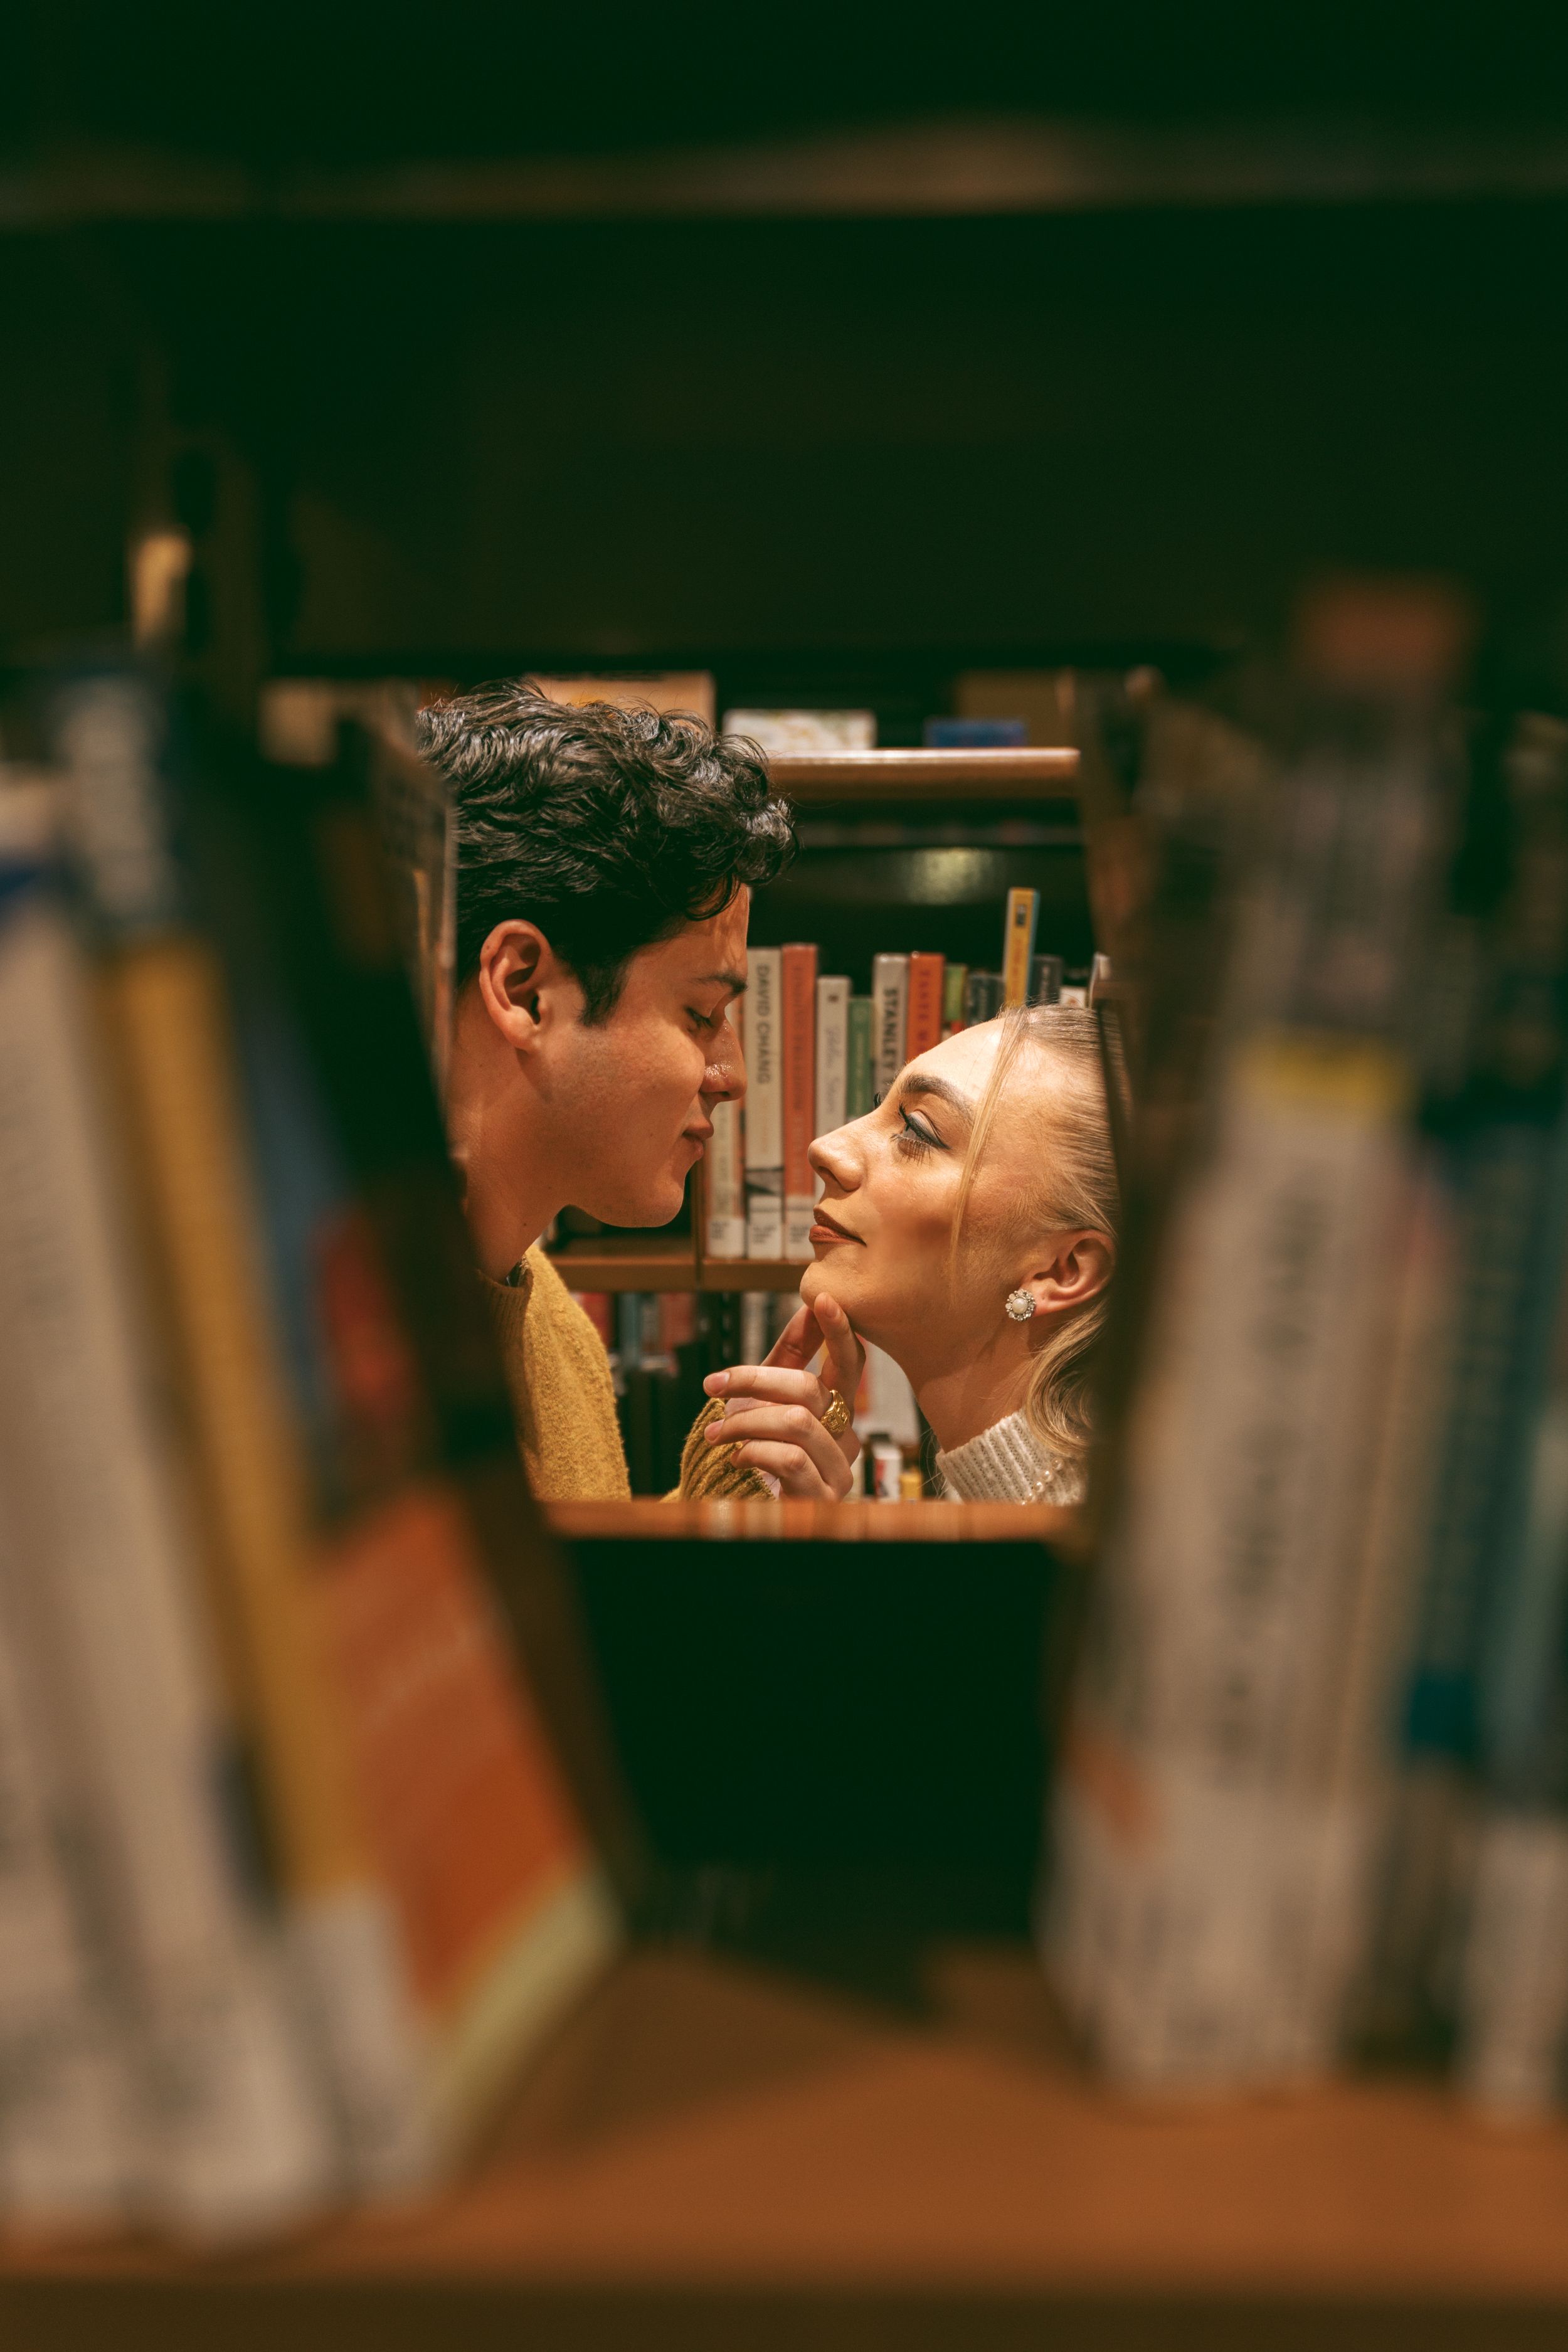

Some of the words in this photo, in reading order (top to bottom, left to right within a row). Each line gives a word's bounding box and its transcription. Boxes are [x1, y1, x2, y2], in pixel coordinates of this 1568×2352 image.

[757, 964, 770, 1017] DAVID
[757, 1022, 770, 1084] CHANG
[883, 987, 899, 1069] STANLEY
